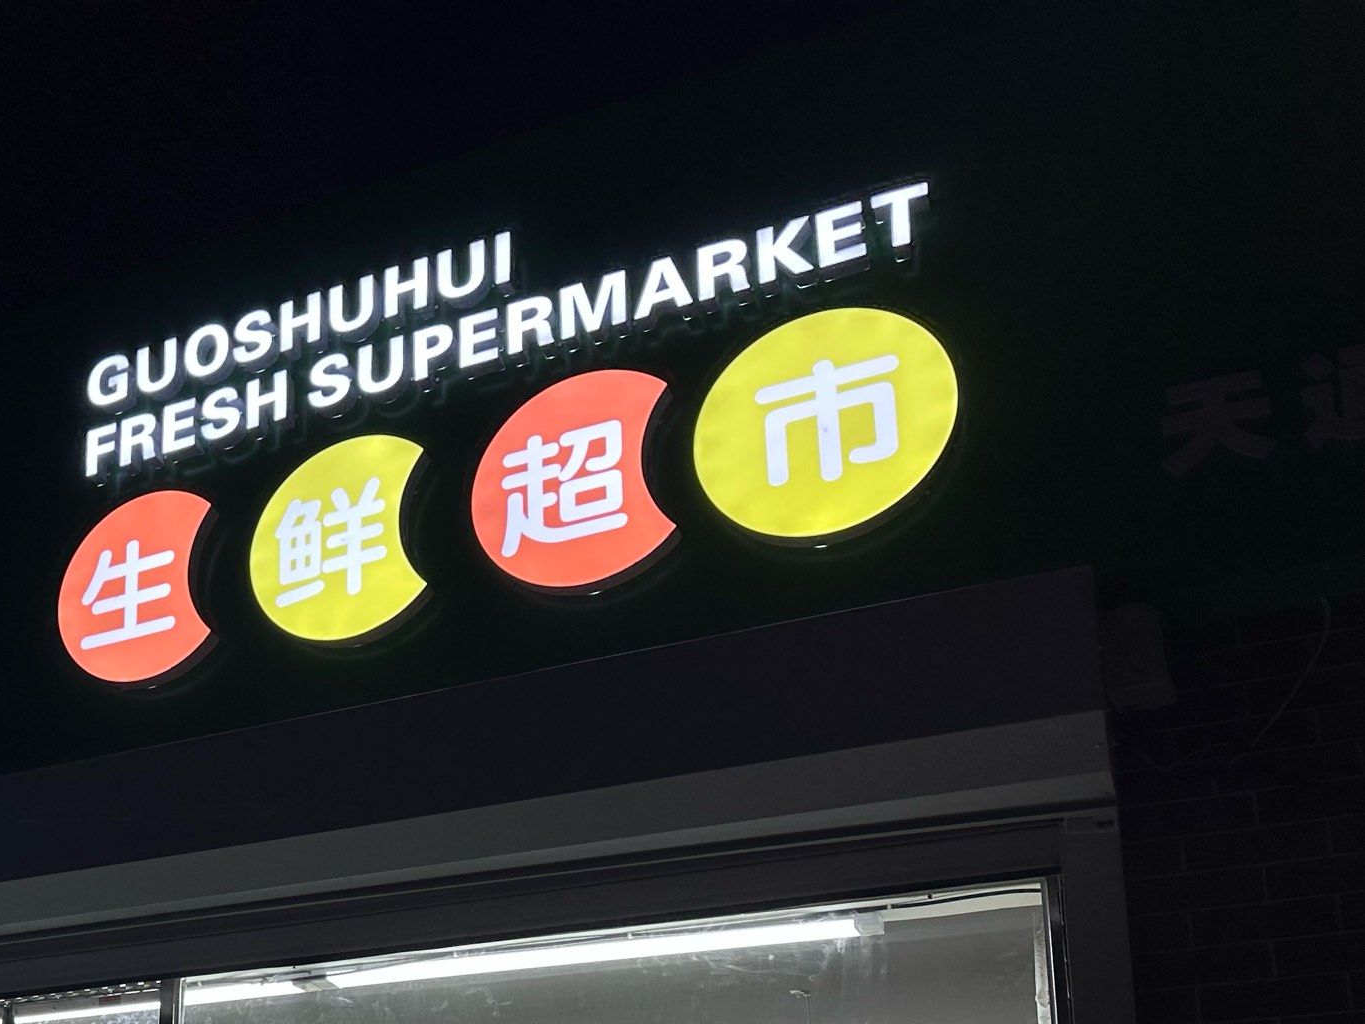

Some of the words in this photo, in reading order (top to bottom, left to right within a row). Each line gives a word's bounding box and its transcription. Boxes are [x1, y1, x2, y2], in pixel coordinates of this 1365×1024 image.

[84, 377, 291, 477] FRESH
[307, 181, 930, 409] SUPERMARKET
[86, 231, 514, 408] GUOSHUHUI
[80, 354, 900, 651] 生鲜超市
